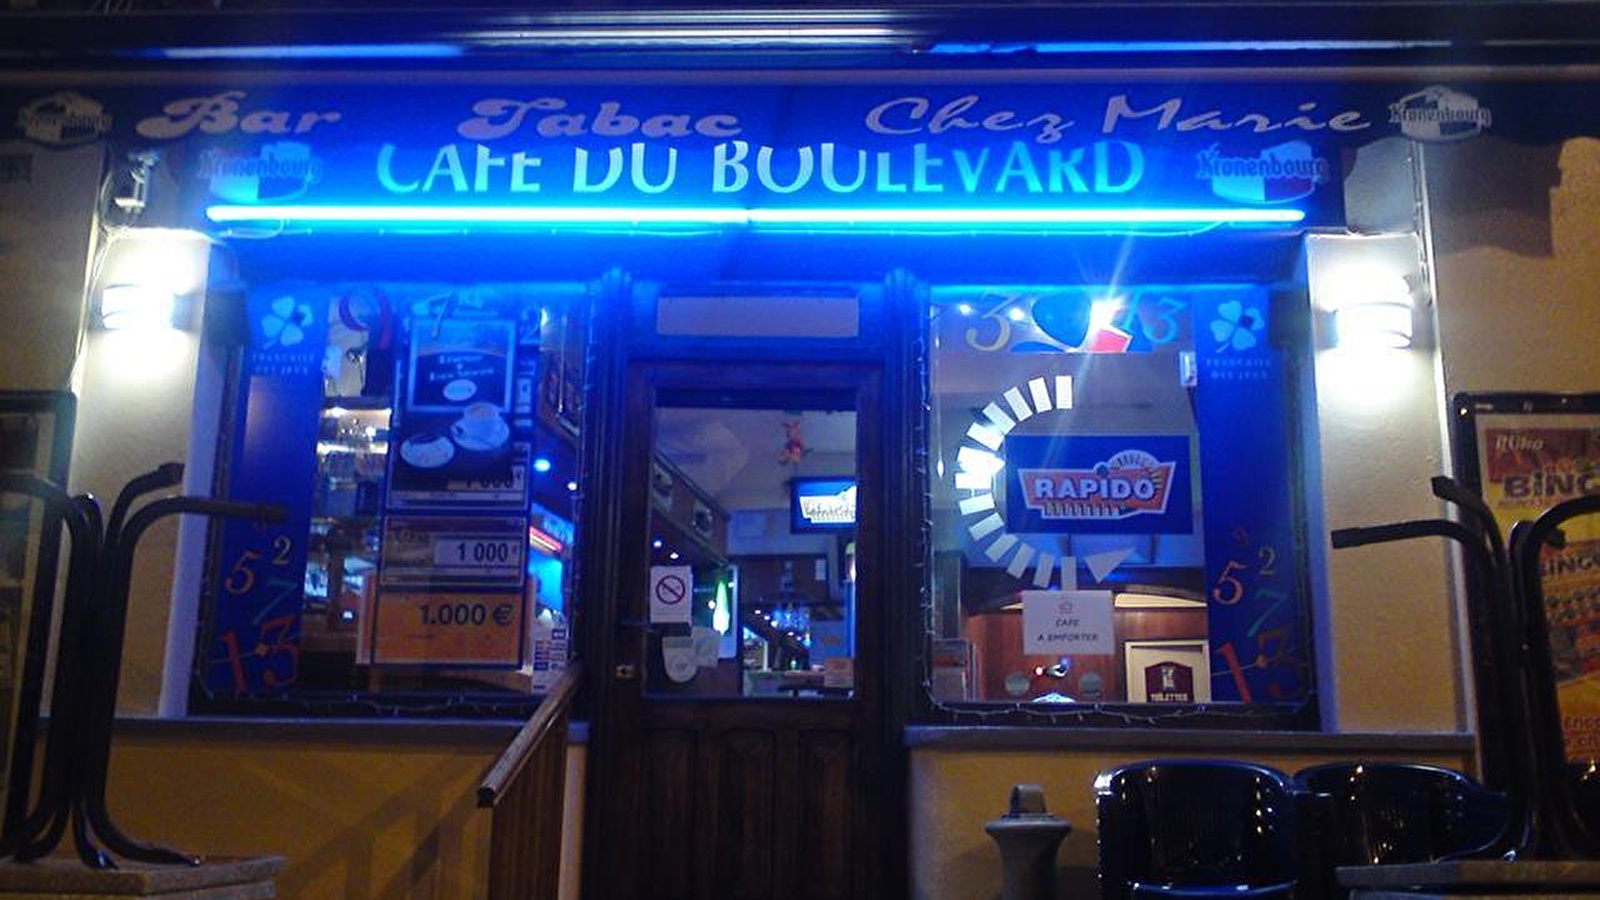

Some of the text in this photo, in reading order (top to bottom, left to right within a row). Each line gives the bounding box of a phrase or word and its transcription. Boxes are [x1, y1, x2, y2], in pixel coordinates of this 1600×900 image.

[135, 90, 1371, 143] Bar Tabac Chez Marie
[1387, 102, 1492, 128] Kronenbourg
[573, 142, 677, 194] DU
[712, 140, 1145, 193] BOULEVARD
[1197, 143, 1330, 182] Kronenbourg
[1035, 478, 1154, 500] RAPIDO
[273, 535, 292, 565] 2
[458, 543, 466, 561] 1
[474, 543, 509, 562] 000
[1259, 546, 1277, 576] 2
[225, 550, 263, 595] 5
[1213, 559, 1248, 605] 5
[419, 603, 513, 626] 1.000 €
